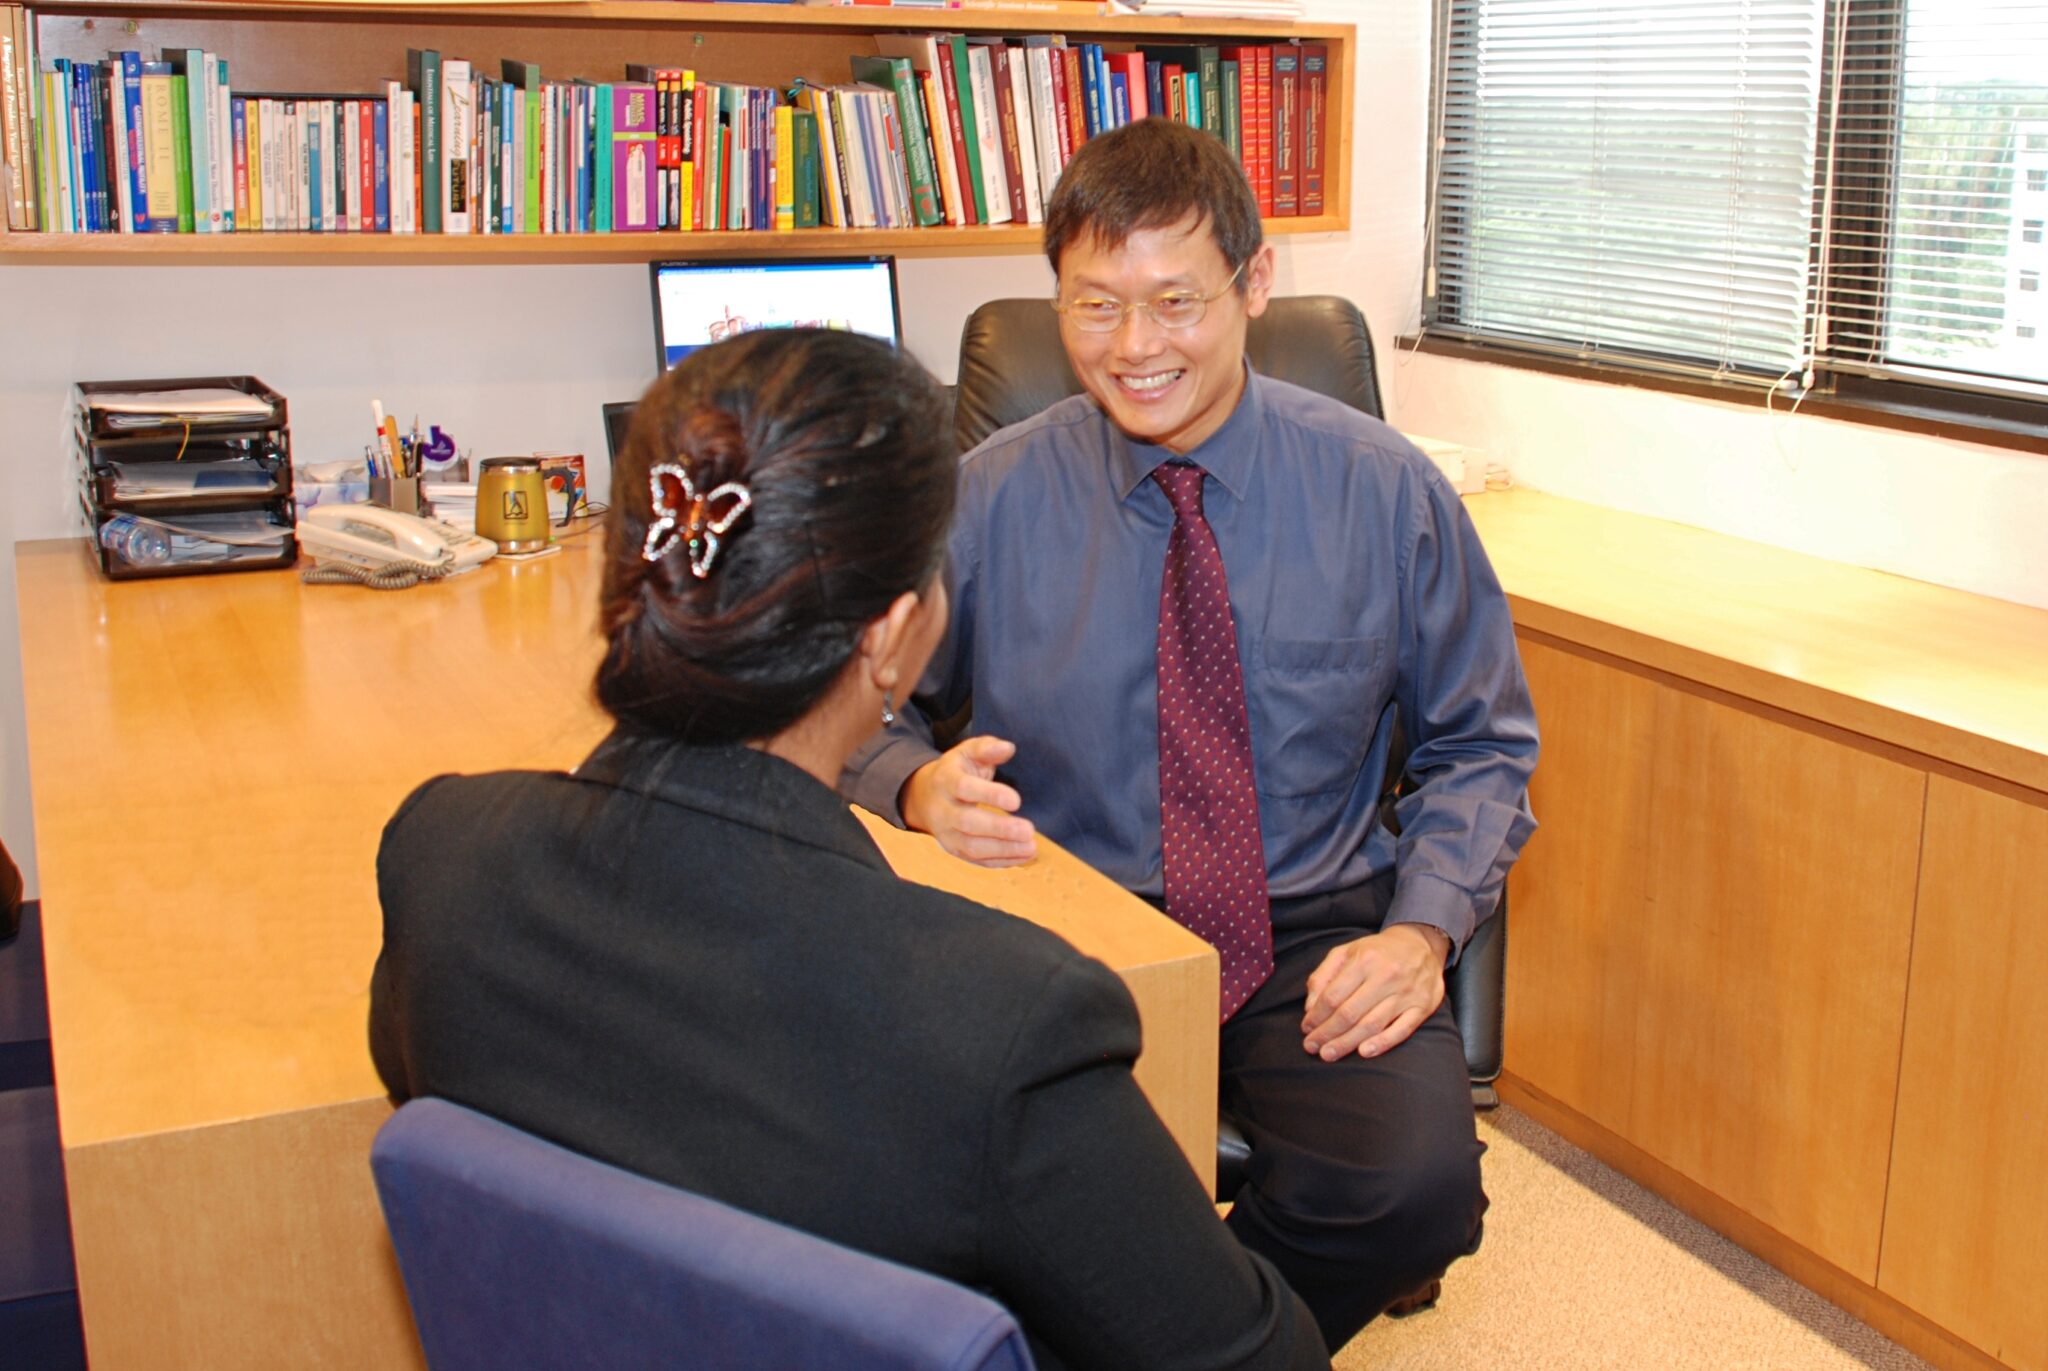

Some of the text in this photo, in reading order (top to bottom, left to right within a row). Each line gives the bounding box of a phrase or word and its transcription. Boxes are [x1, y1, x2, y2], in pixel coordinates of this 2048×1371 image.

[3, 44, 14, 83] Biography
[7, 85, 15, 93] of
[427, 68, 435, 104] ESSENTIALS
[1282, 78, 1291, 124] Gastrointestinal
[8, 95, 17, 129] President
[156, 84, 170, 160] ROME II
[447, 86, 470, 157] Learning
[636, 93, 645, 123] MIMS
[684, 98, 693, 120] Public
[981, 91, 989, 118] DISEASE
[428, 116, 436, 146] MEDICAL
[682, 120, 692, 155] Speaking
[1059, 115, 1070, 153] Postgraduate
[452, 160, 460, 210] FUTURE
[1260, 166, 1265, 176] 1
